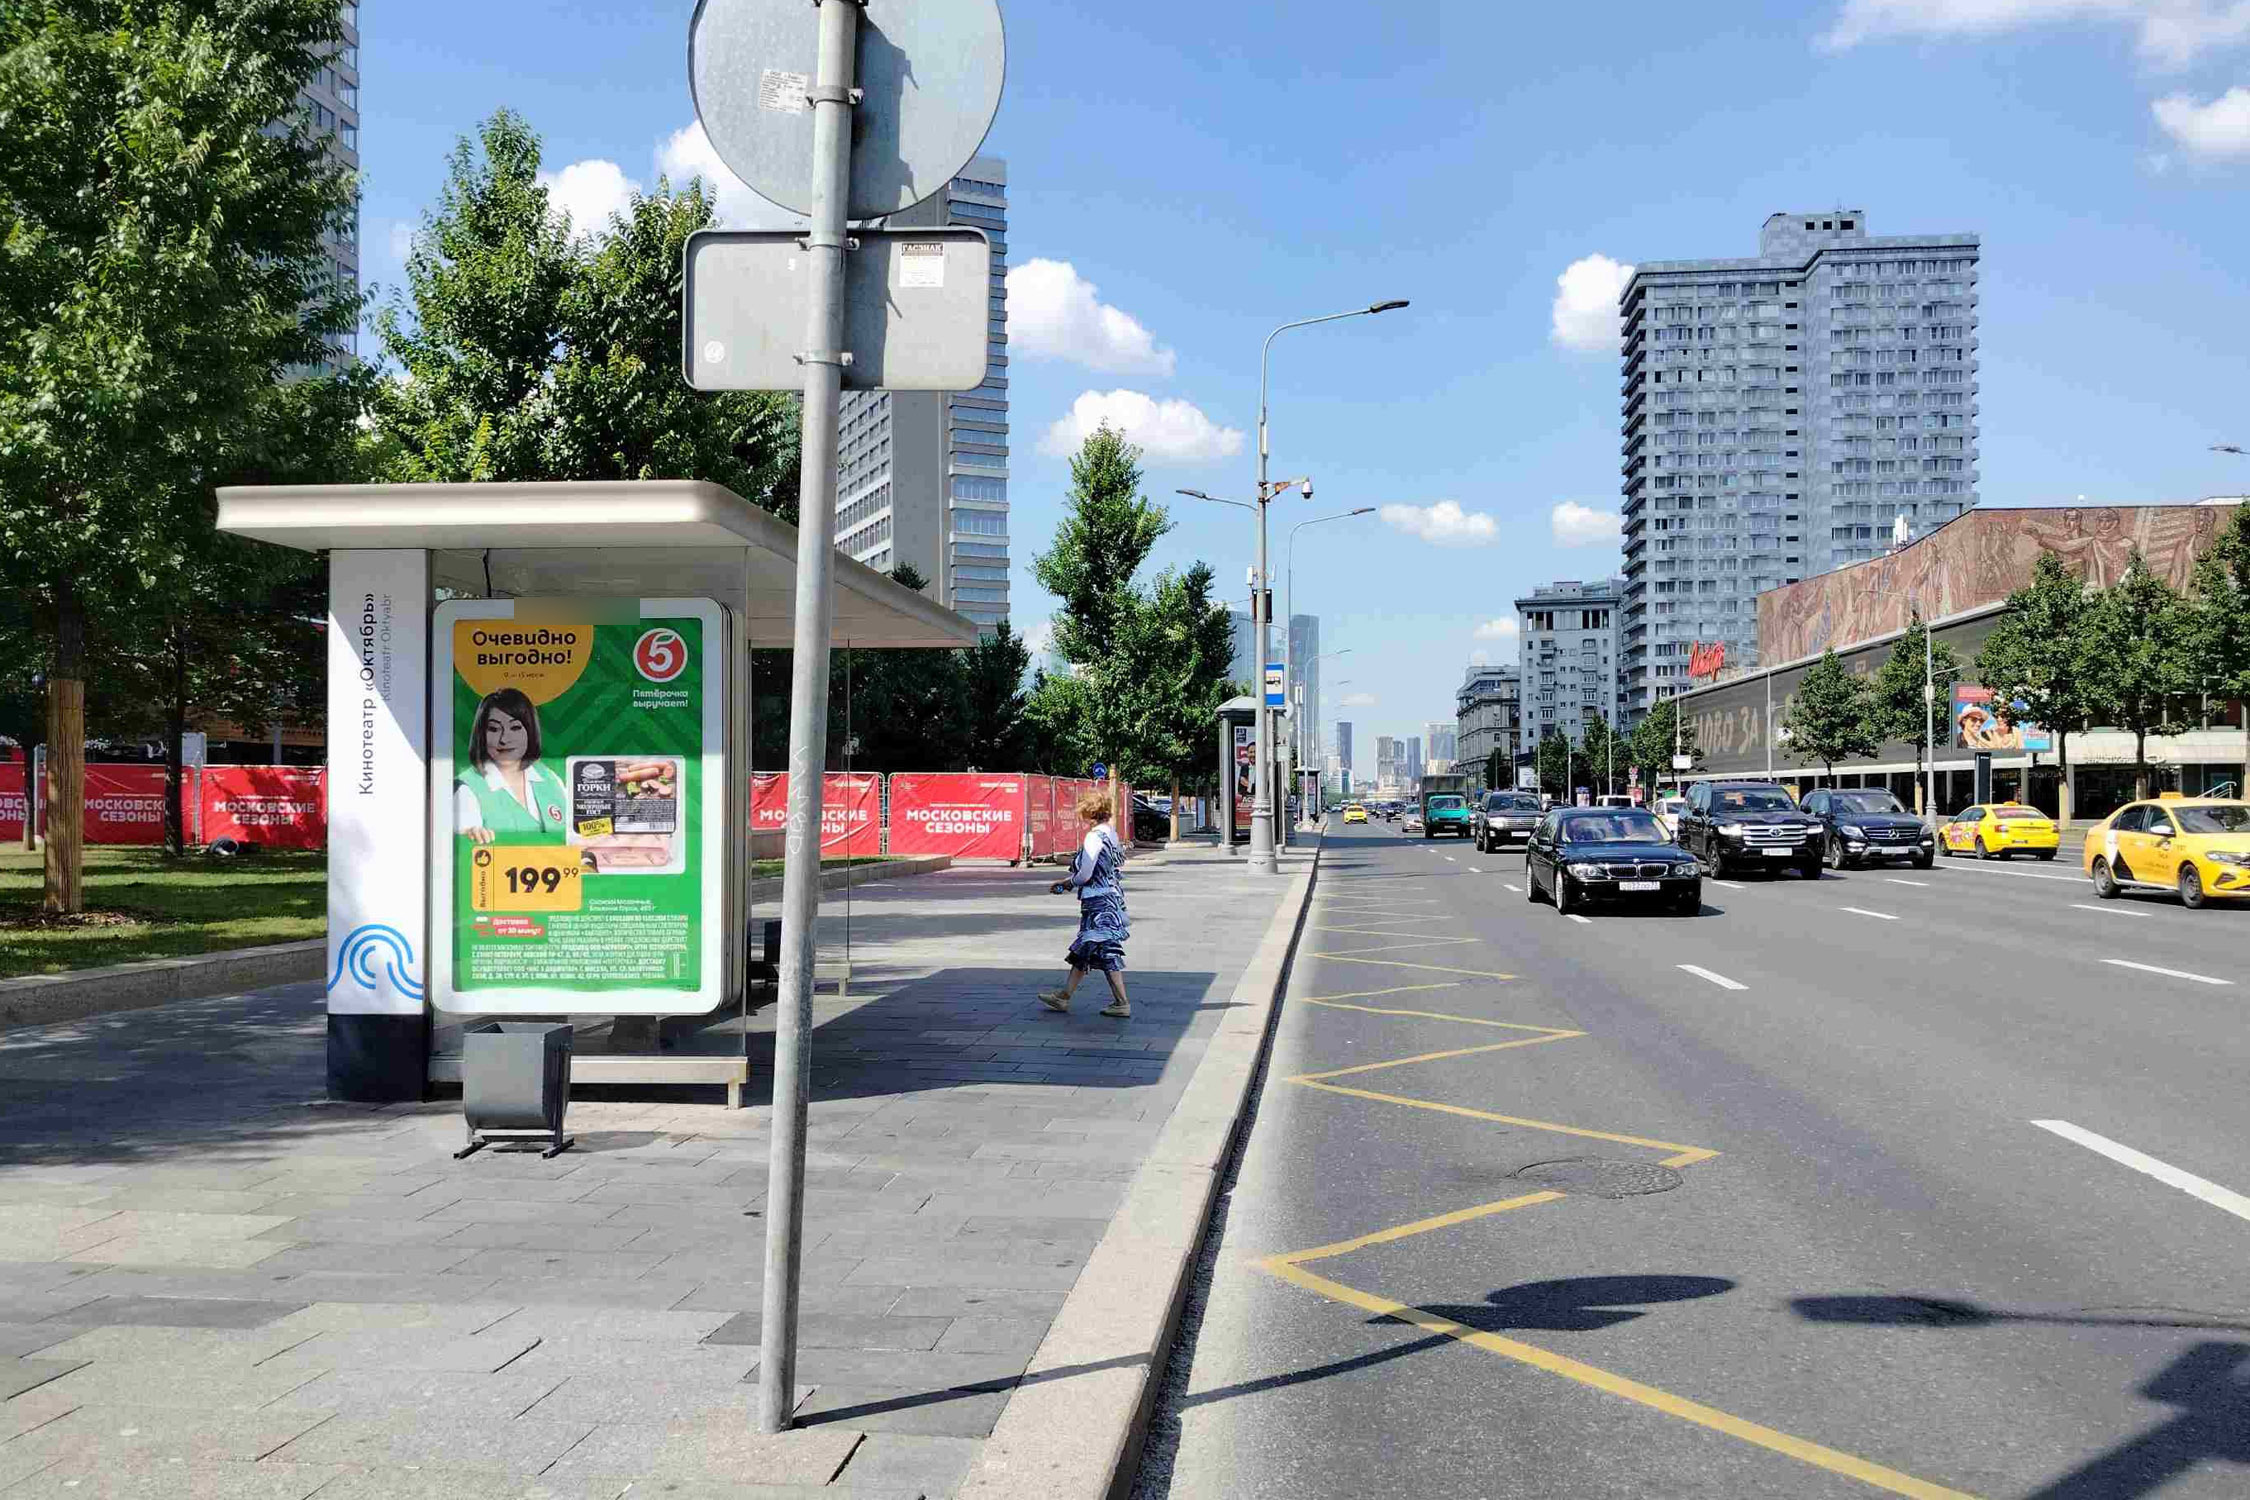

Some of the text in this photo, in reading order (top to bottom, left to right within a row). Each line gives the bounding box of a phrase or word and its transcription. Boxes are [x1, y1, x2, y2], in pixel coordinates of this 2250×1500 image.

[472, 629, 577, 647] Очевидно
[380, 593, 394, 701] Kinoteatr Oktyabr
[477, 649, 572, 666] выгодно!
[359, 593, 378, 795] Кинотеатр «Октябрь»
[632, 689, 689, 700] Пятёрочка
[632, 699, 689, 709] выручает!
[577, 783, 611, 792] ГОРКИ
[214, 801, 316, 814] МОСКОВСКИЕ
[100, 811, 161, 823] СЕЗОНЫ
[232, 813, 294, 826] СЕЗОНЫ
[906, 809, 1012, 822] МОСКОВСКИЕ
[925, 821, 990, 834] СЕЗОНЫ
[504, 867, 580, 894] 199 99
